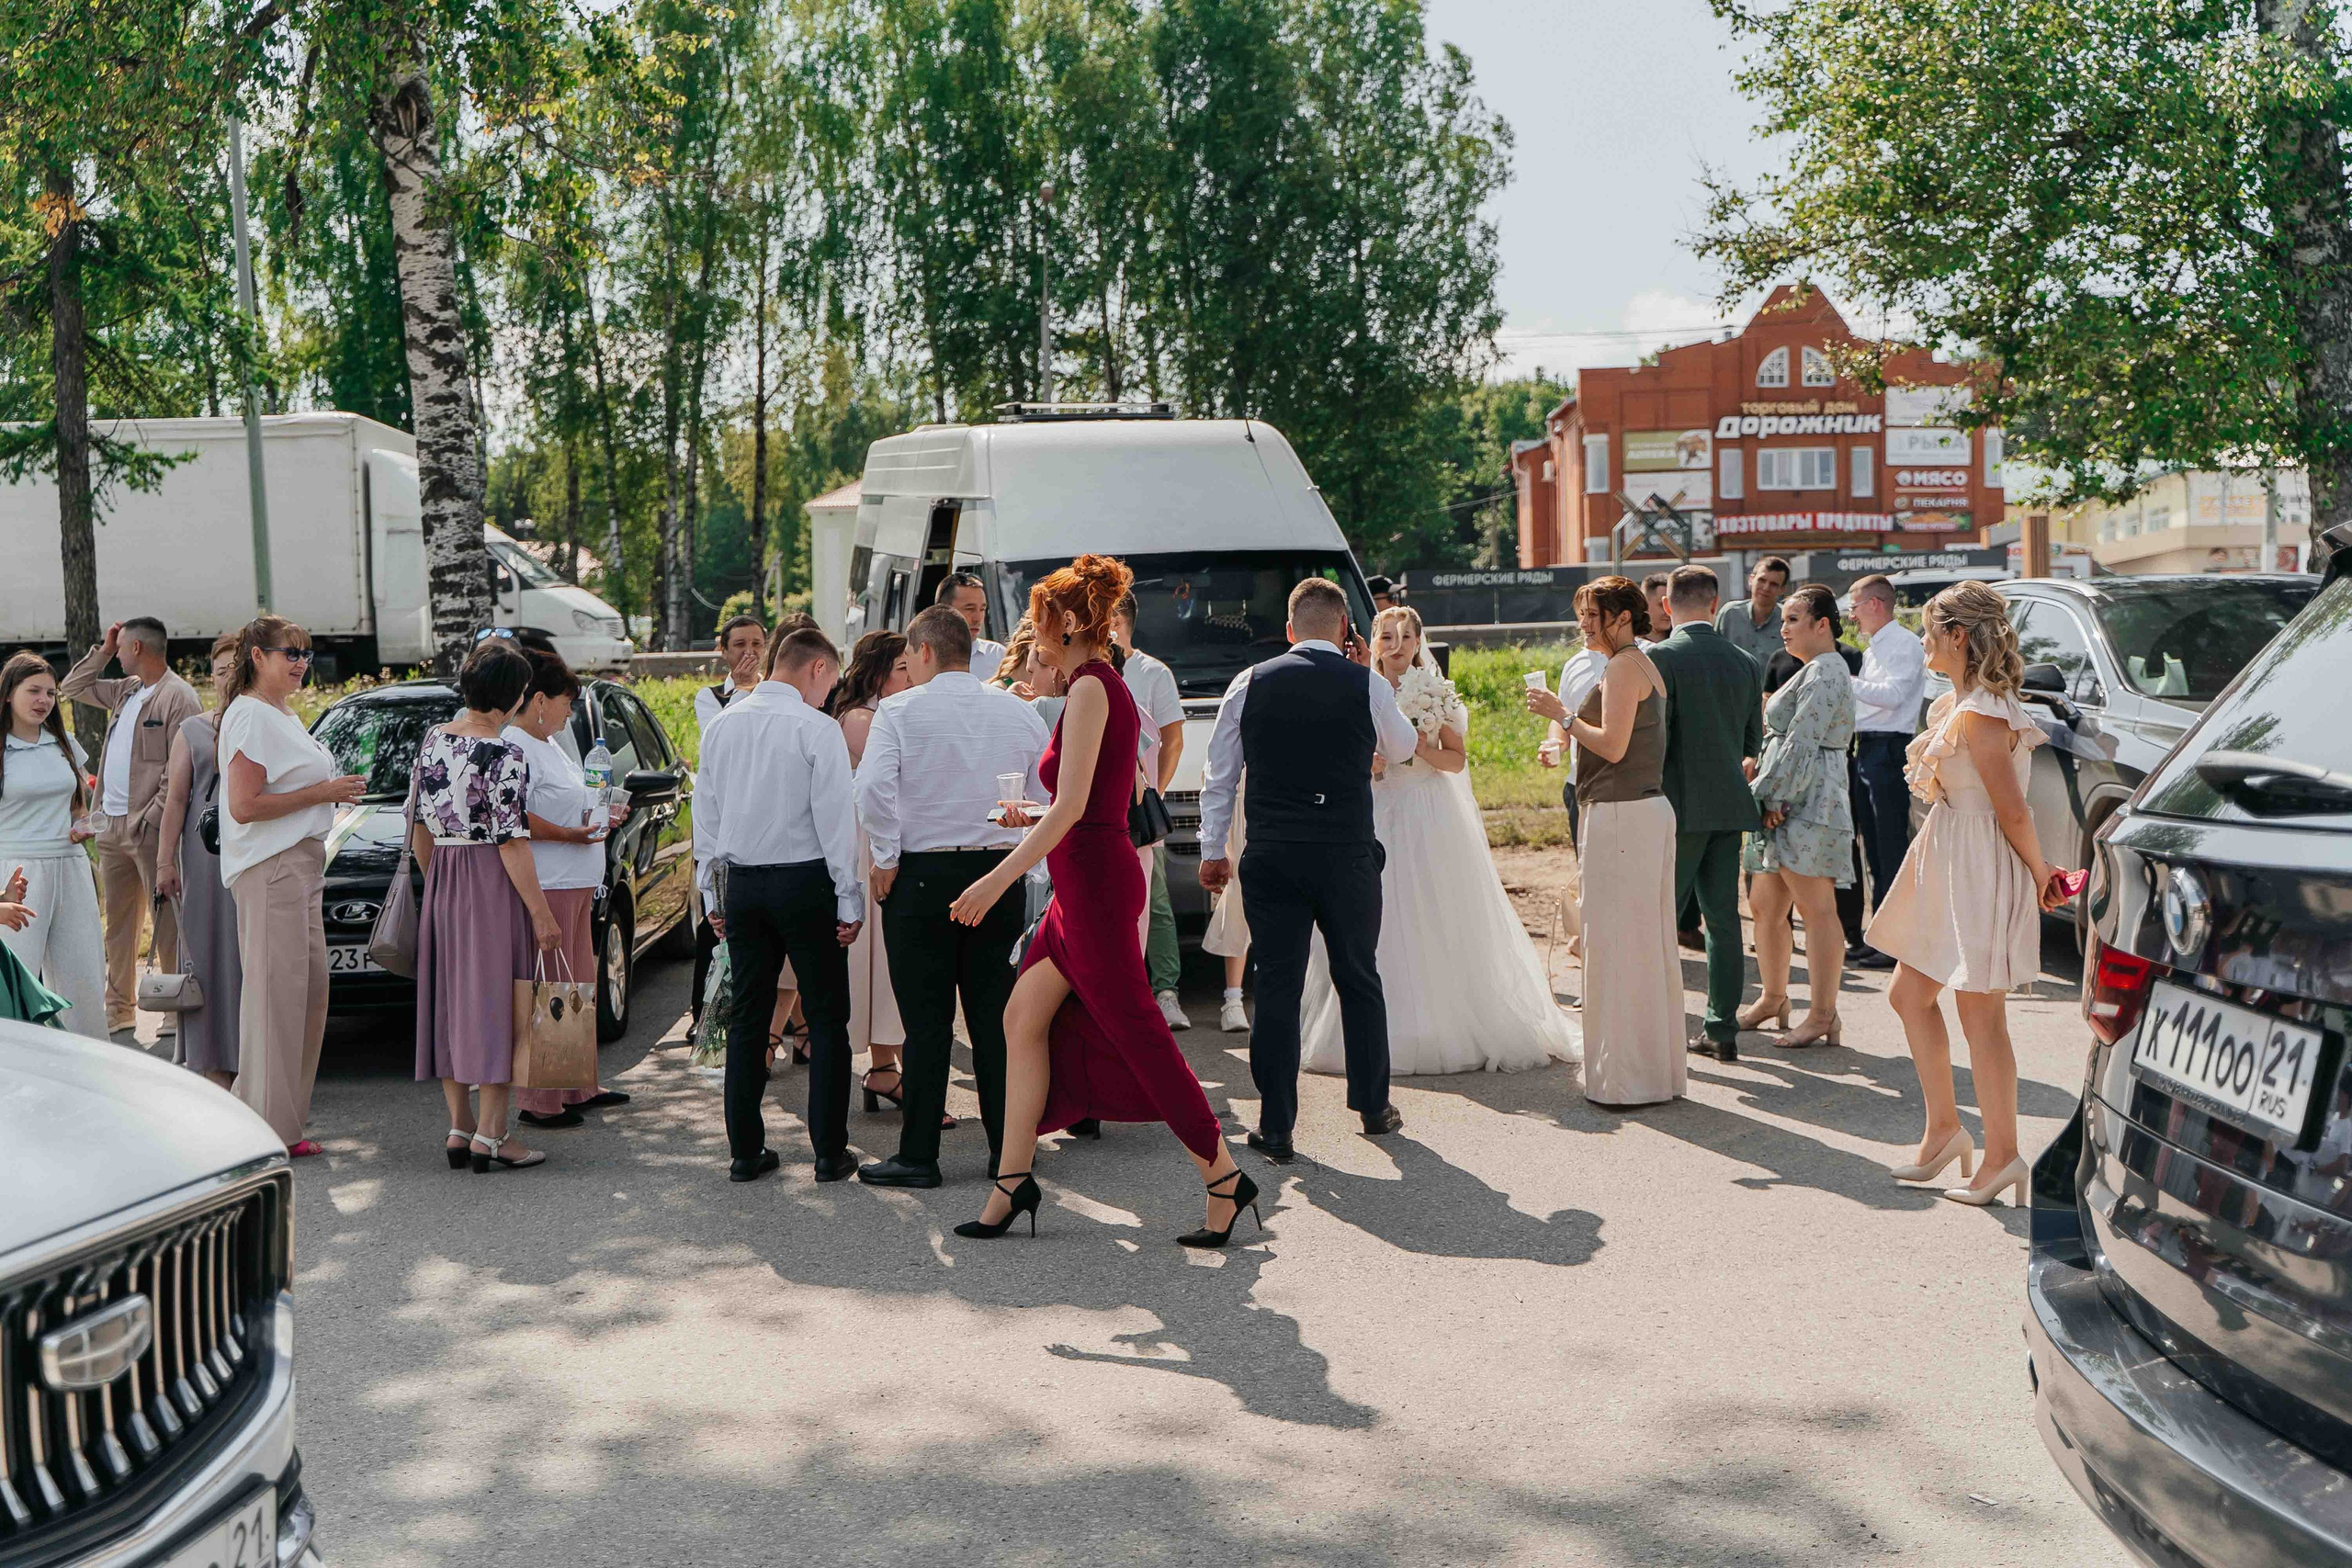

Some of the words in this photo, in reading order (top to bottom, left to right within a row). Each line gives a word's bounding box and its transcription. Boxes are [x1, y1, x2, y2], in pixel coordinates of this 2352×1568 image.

[1907, 435, 1965, 450] РЫА
[1912, 469, 1968, 487] МЯСО
[1816, 512, 1894, 532] ПРОДУКТЫ
[1838, 555, 1928, 571] ФЕРМЕРСКИЕ
[1929, 553, 1969, 568] РЯДЫ
[1432, 572, 1514, 587] ФЕРМЕРСКИЕ
[1518, 571, 1554, 585] РЯДЫ
[2261, 1030, 2306, 1095] 21
[2258, 1089, 2287, 1119] RUS
[233, 1506, 263, 1568] 21
